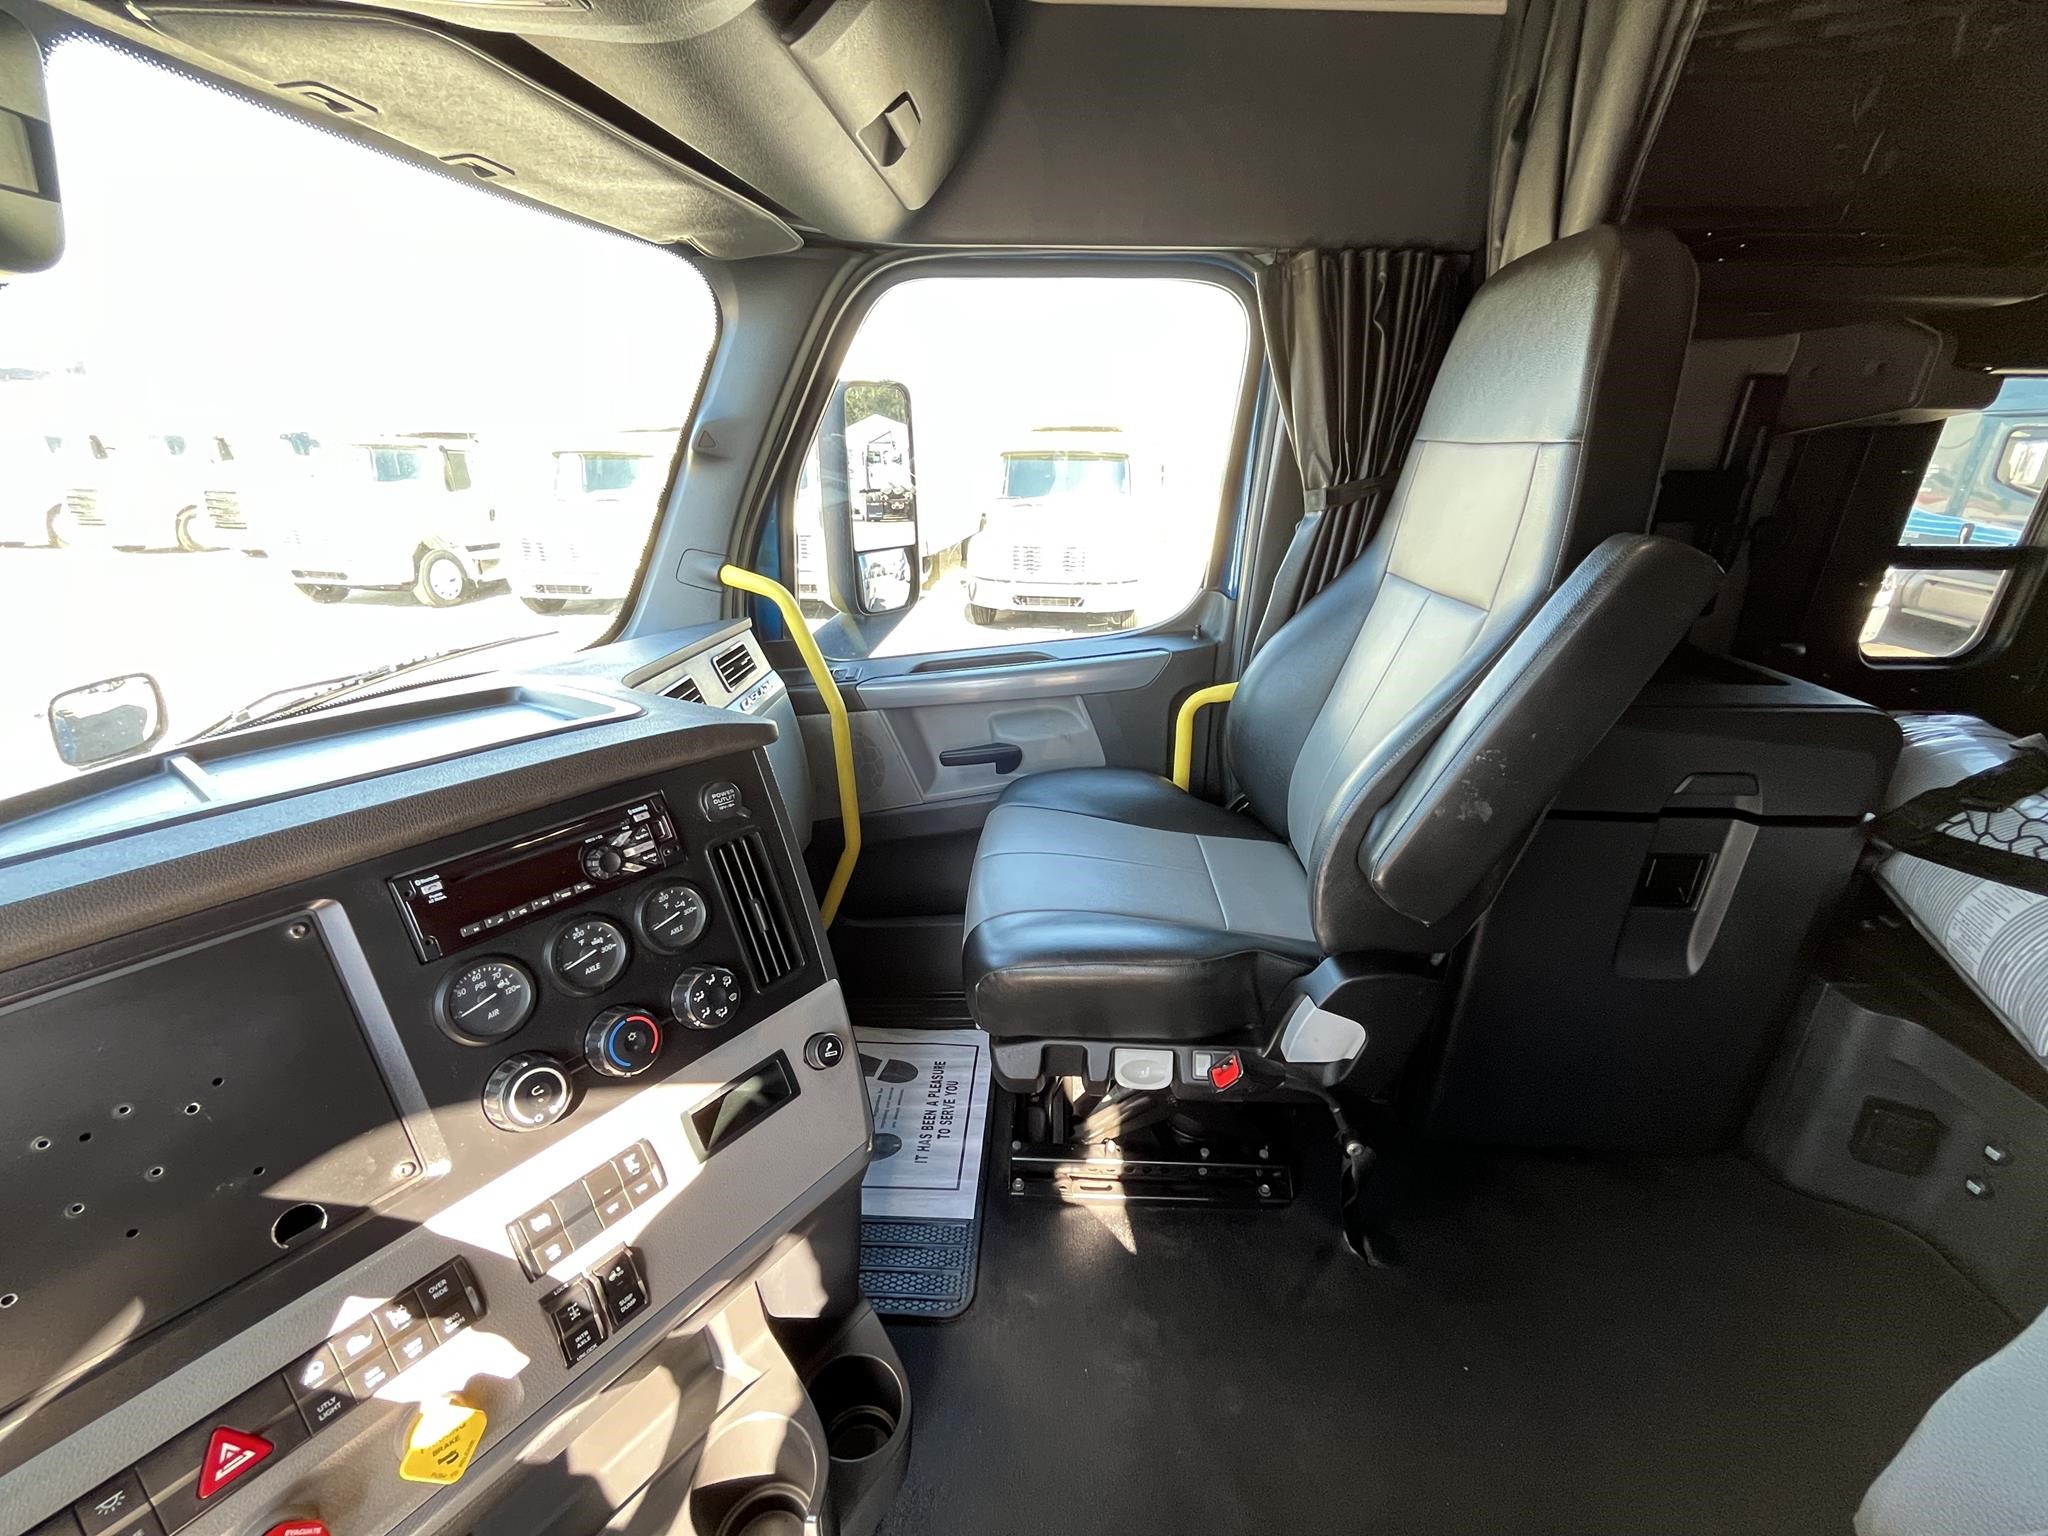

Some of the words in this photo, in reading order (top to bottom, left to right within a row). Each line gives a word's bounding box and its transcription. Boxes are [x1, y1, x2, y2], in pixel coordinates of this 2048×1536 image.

[712, 789, 734, 799] POWER
[713, 794, 735, 804] OUTLET
[572, 930, 585, 940] 200
[670, 924, 684, 936] AXLE
[601, 944, 613, 954] 300
[585, 962, 601, 976] AXLE
[471, 973, 482, 982] 60
[492, 971, 501, 980] 70
[475, 981, 487, 991] PSI
[505, 986, 517, 996] 120
[456, 988, 466, 997] 50
[487, 1008, 500, 1020] AIR
[928, 1060, 947, 1098] PLEASURE
[944, 1080, 959, 1097] YOU
[940, 1099, 956, 1126] SERVE
[921, 1109, 938, 1131] BEEN
[937, 1127, 951, 1139] TO
[917, 1133, 933, 1152] HAS
[914, 1154, 929, 1164] IT
[428, 1279, 447, 1294] OVER
[432, 1286, 448, 1299] RIDE
[620, 1298, 637, 1313] DUMP
[577, 1335, 592, 1349] AXLE
[316, 1396, 336, 1413] UTLY
[319, 1401, 341, 1421] LIGHT
[432, 1435, 459, 1457] BRAKE
